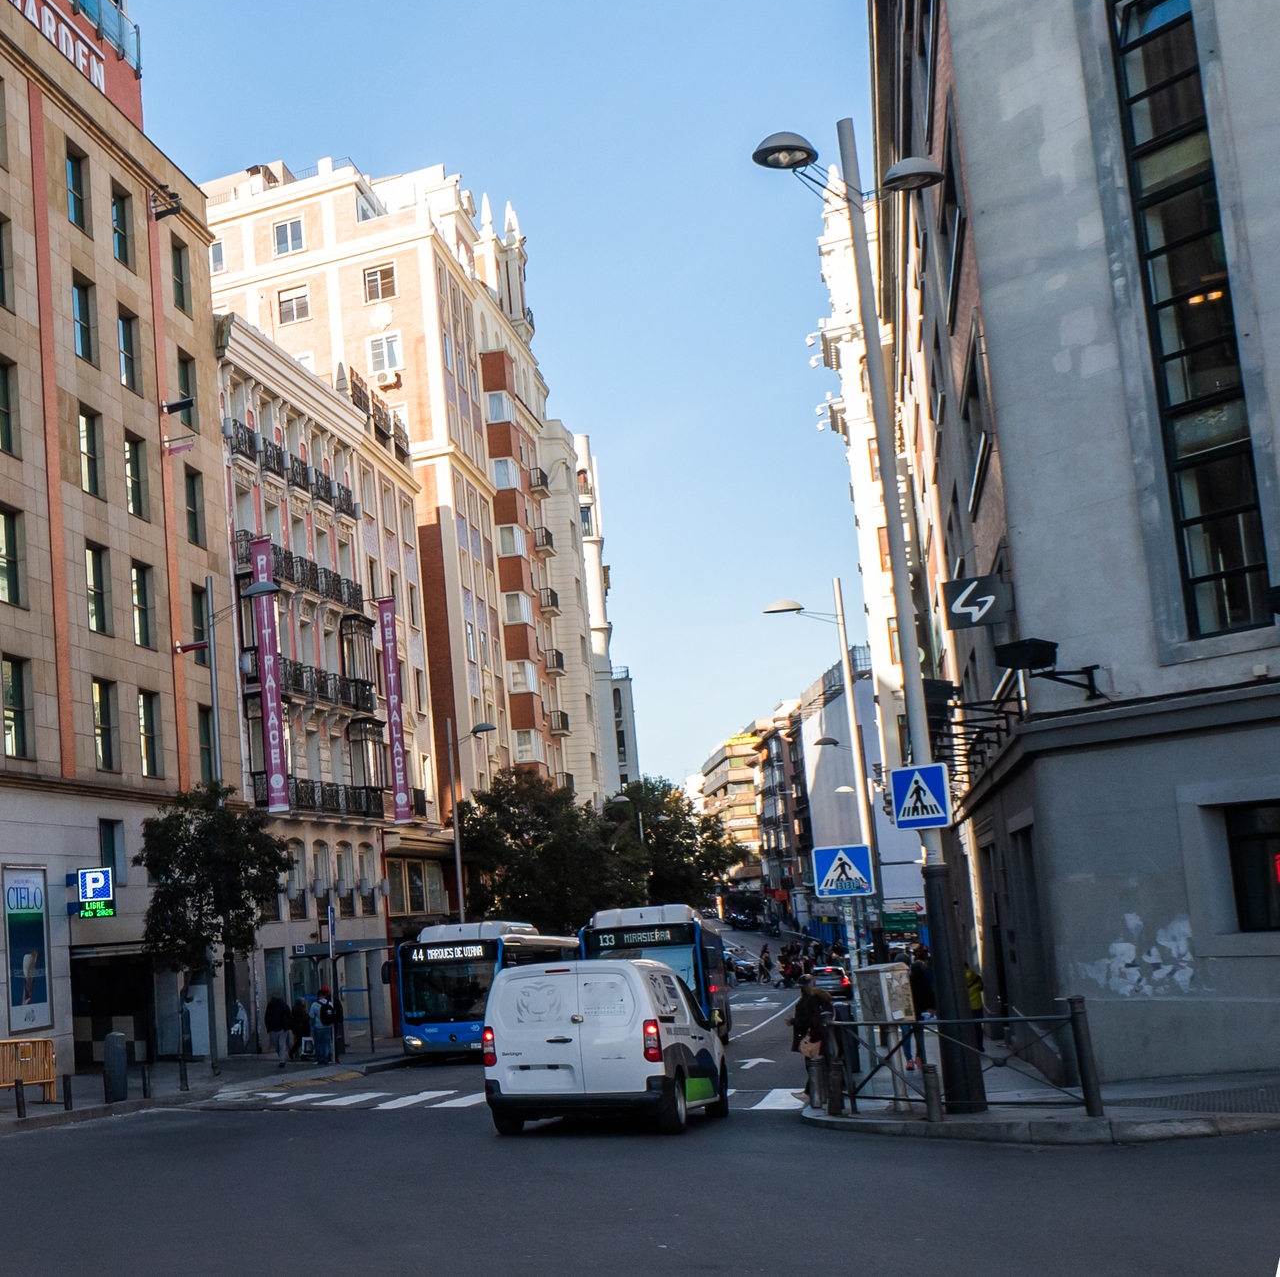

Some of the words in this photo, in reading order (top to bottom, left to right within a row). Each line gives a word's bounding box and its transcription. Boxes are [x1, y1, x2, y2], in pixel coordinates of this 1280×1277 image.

[382, 612, 397, 688] PETIT
[263, 656, 282, 763] PALACE
[389, 694, 405, 785] PALACE
[85, 872, 105, 898] P
[6, 886, 43, 910] CIELO
[86, 901, 106, 910] LIBRE
[80, 910, 94, 918] Feb
[598, 934, 616, 946] 133
[624, 929, 672, 944] MIRASIERRA
[412, 948, 424, 962] 44
[426, 948, 454, 960] MARQUES
[454, 947, 463, 958] DE
[463, 946, 484, 957] VIANA
